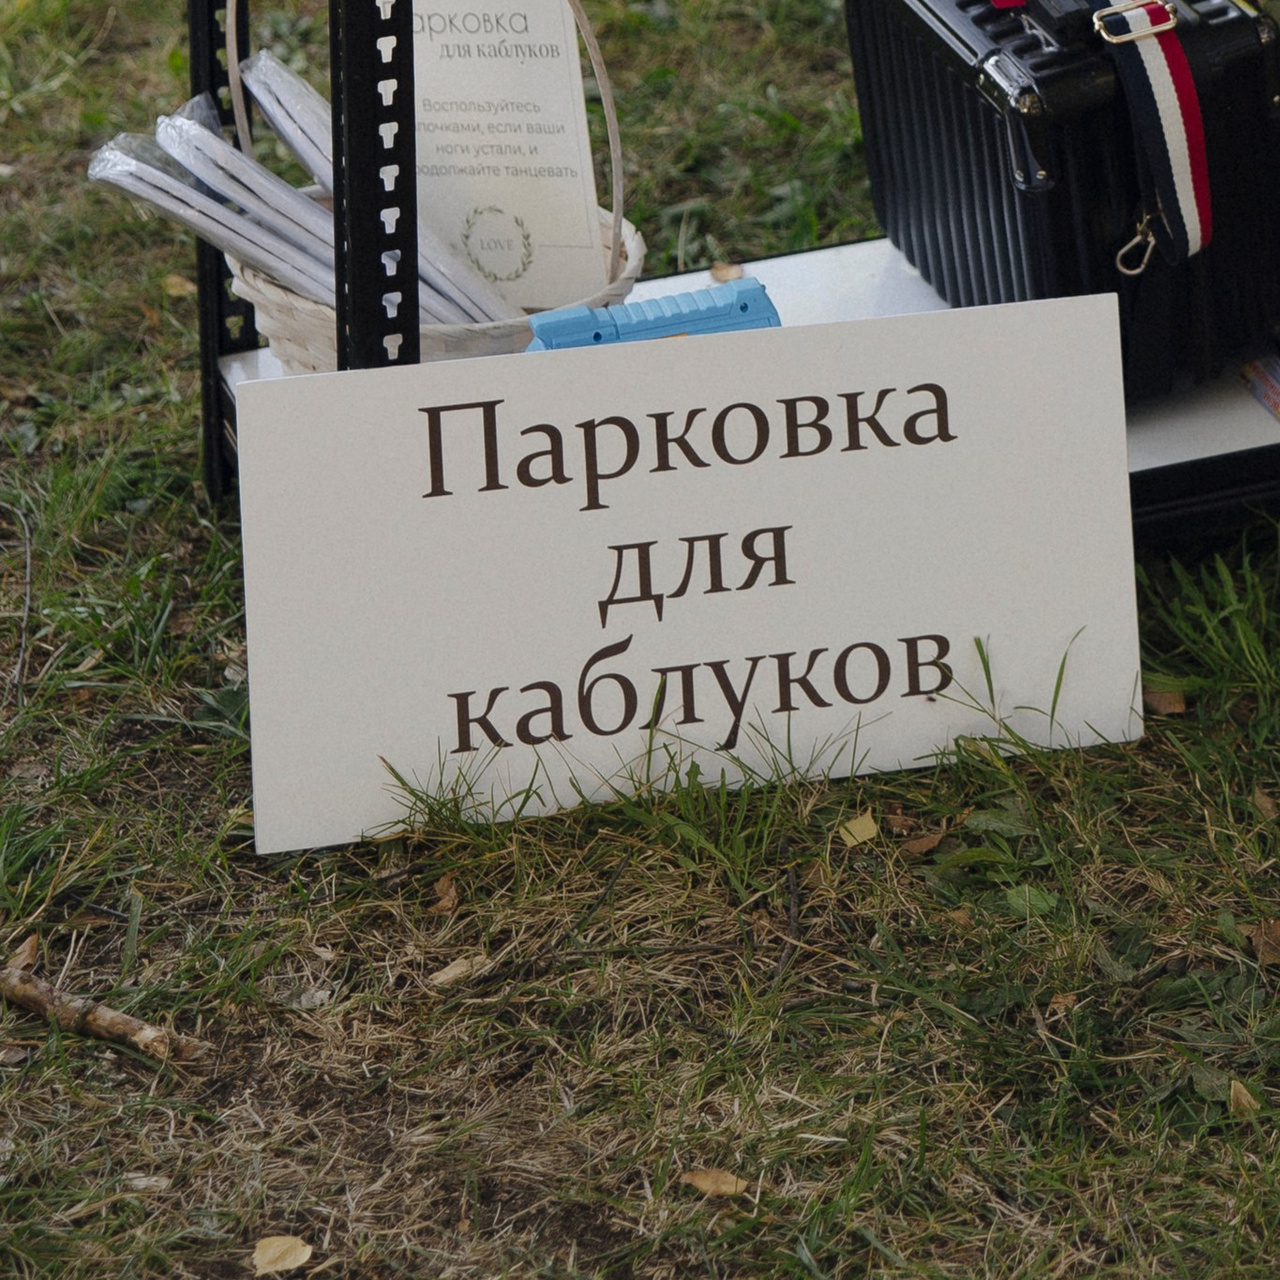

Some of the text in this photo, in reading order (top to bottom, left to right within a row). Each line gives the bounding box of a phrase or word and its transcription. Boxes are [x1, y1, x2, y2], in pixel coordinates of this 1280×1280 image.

[413, 12, 528, 41] арковка
[440, 39, 560, 64] для каблуков
[422, 98, 542, 116] Воспользуйтесь
[417, 121, 486, 136] почками,
[417, 382, 958, 512] Парковка
[597, 525, 796, 629] для
[446, 633, 954, 754] каблуков
